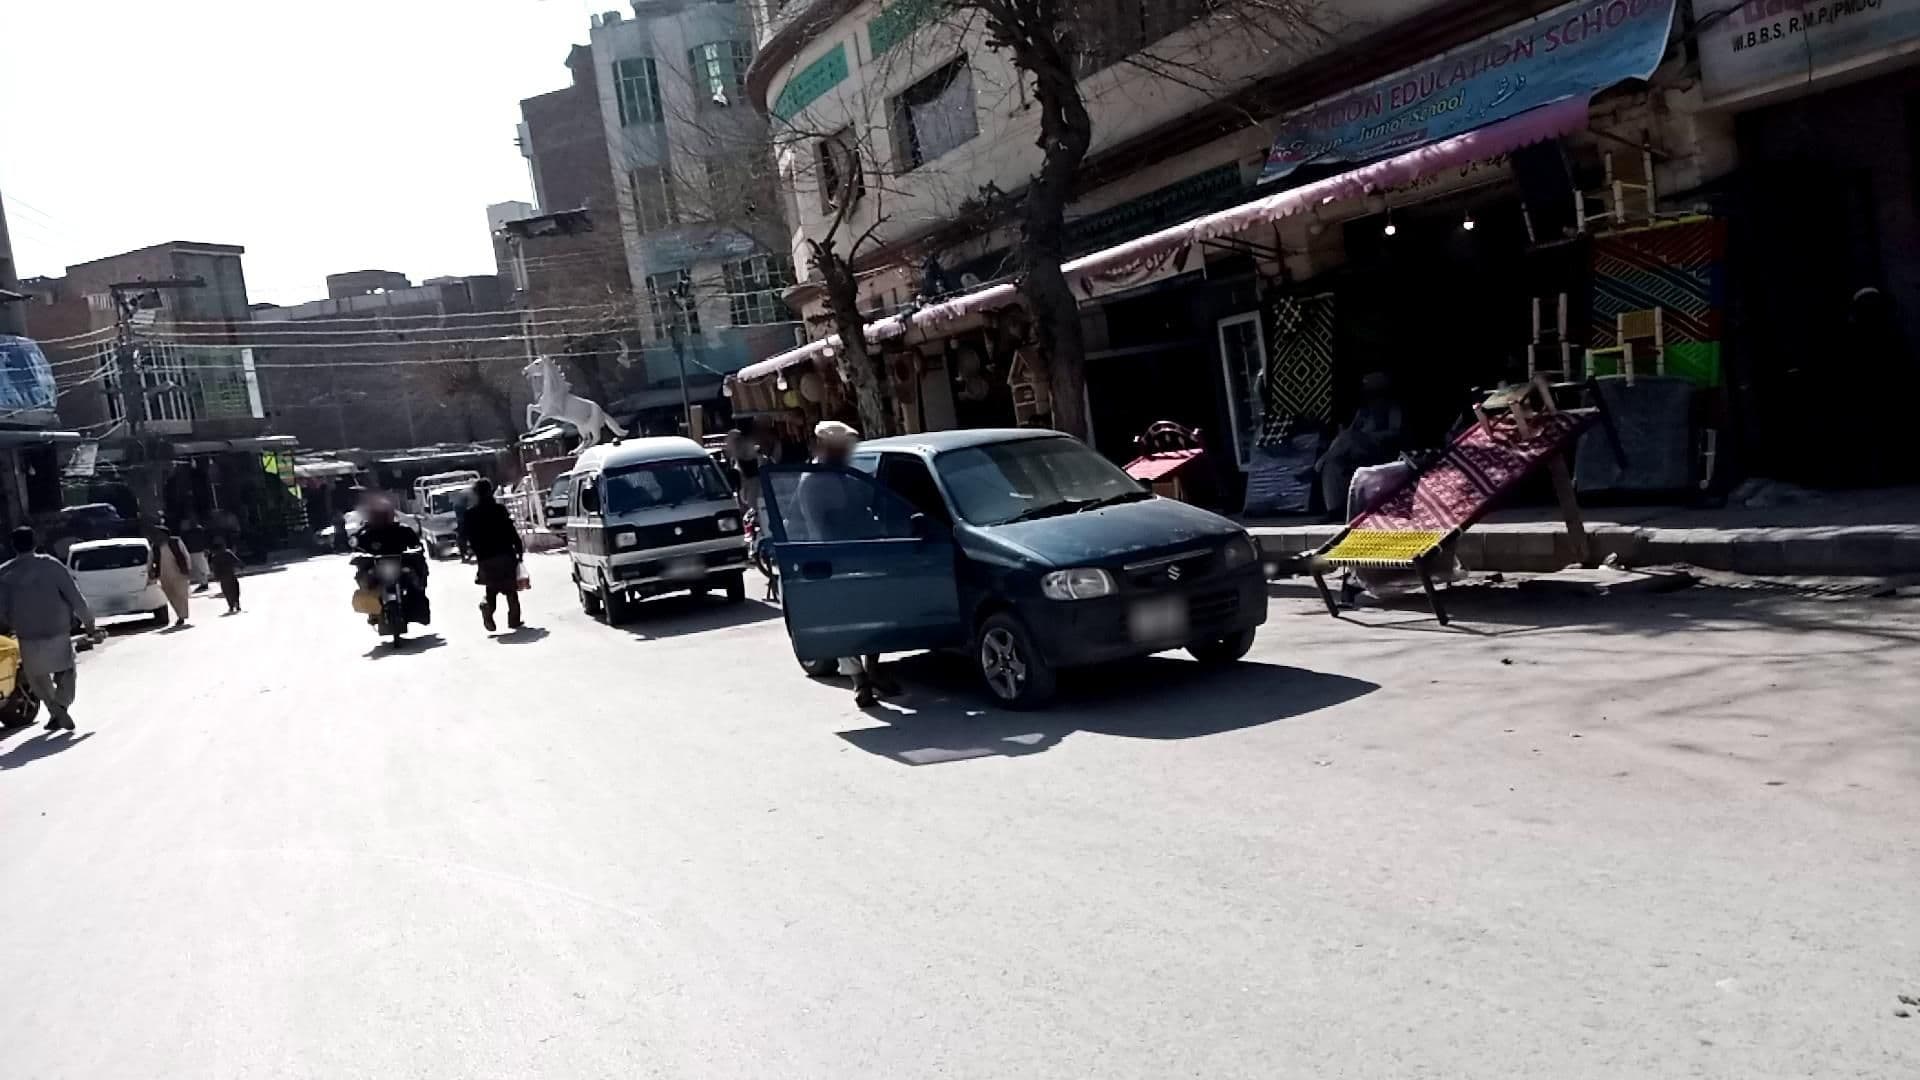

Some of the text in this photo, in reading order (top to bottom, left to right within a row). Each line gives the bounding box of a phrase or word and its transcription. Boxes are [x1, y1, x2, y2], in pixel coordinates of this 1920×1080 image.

[1391, 35, 1534, 109] EDUCATION
[1360, 118, 1409, 143] Junior
[1412, 88, 1466, 121] School
